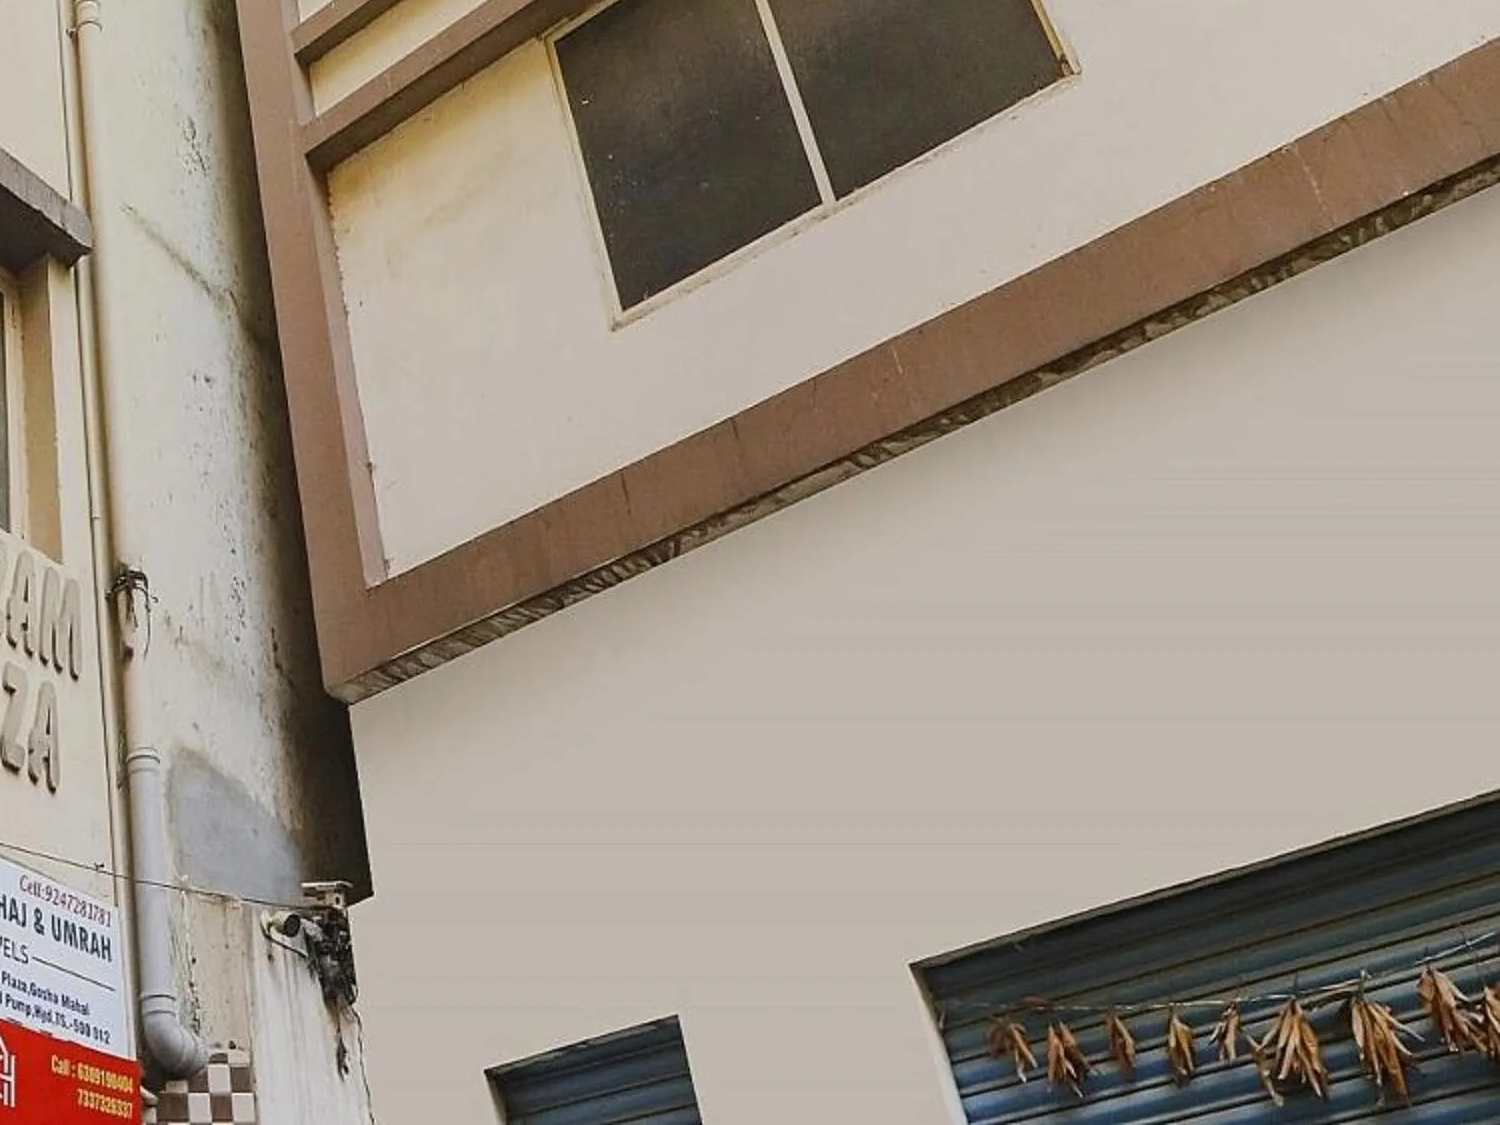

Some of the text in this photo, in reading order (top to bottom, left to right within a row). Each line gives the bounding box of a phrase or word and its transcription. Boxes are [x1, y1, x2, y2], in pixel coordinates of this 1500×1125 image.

[33, 907, 45, 935] &
[51, 915, 113, 963] UMRAH
[51, 1055, 71, 1076] Call
